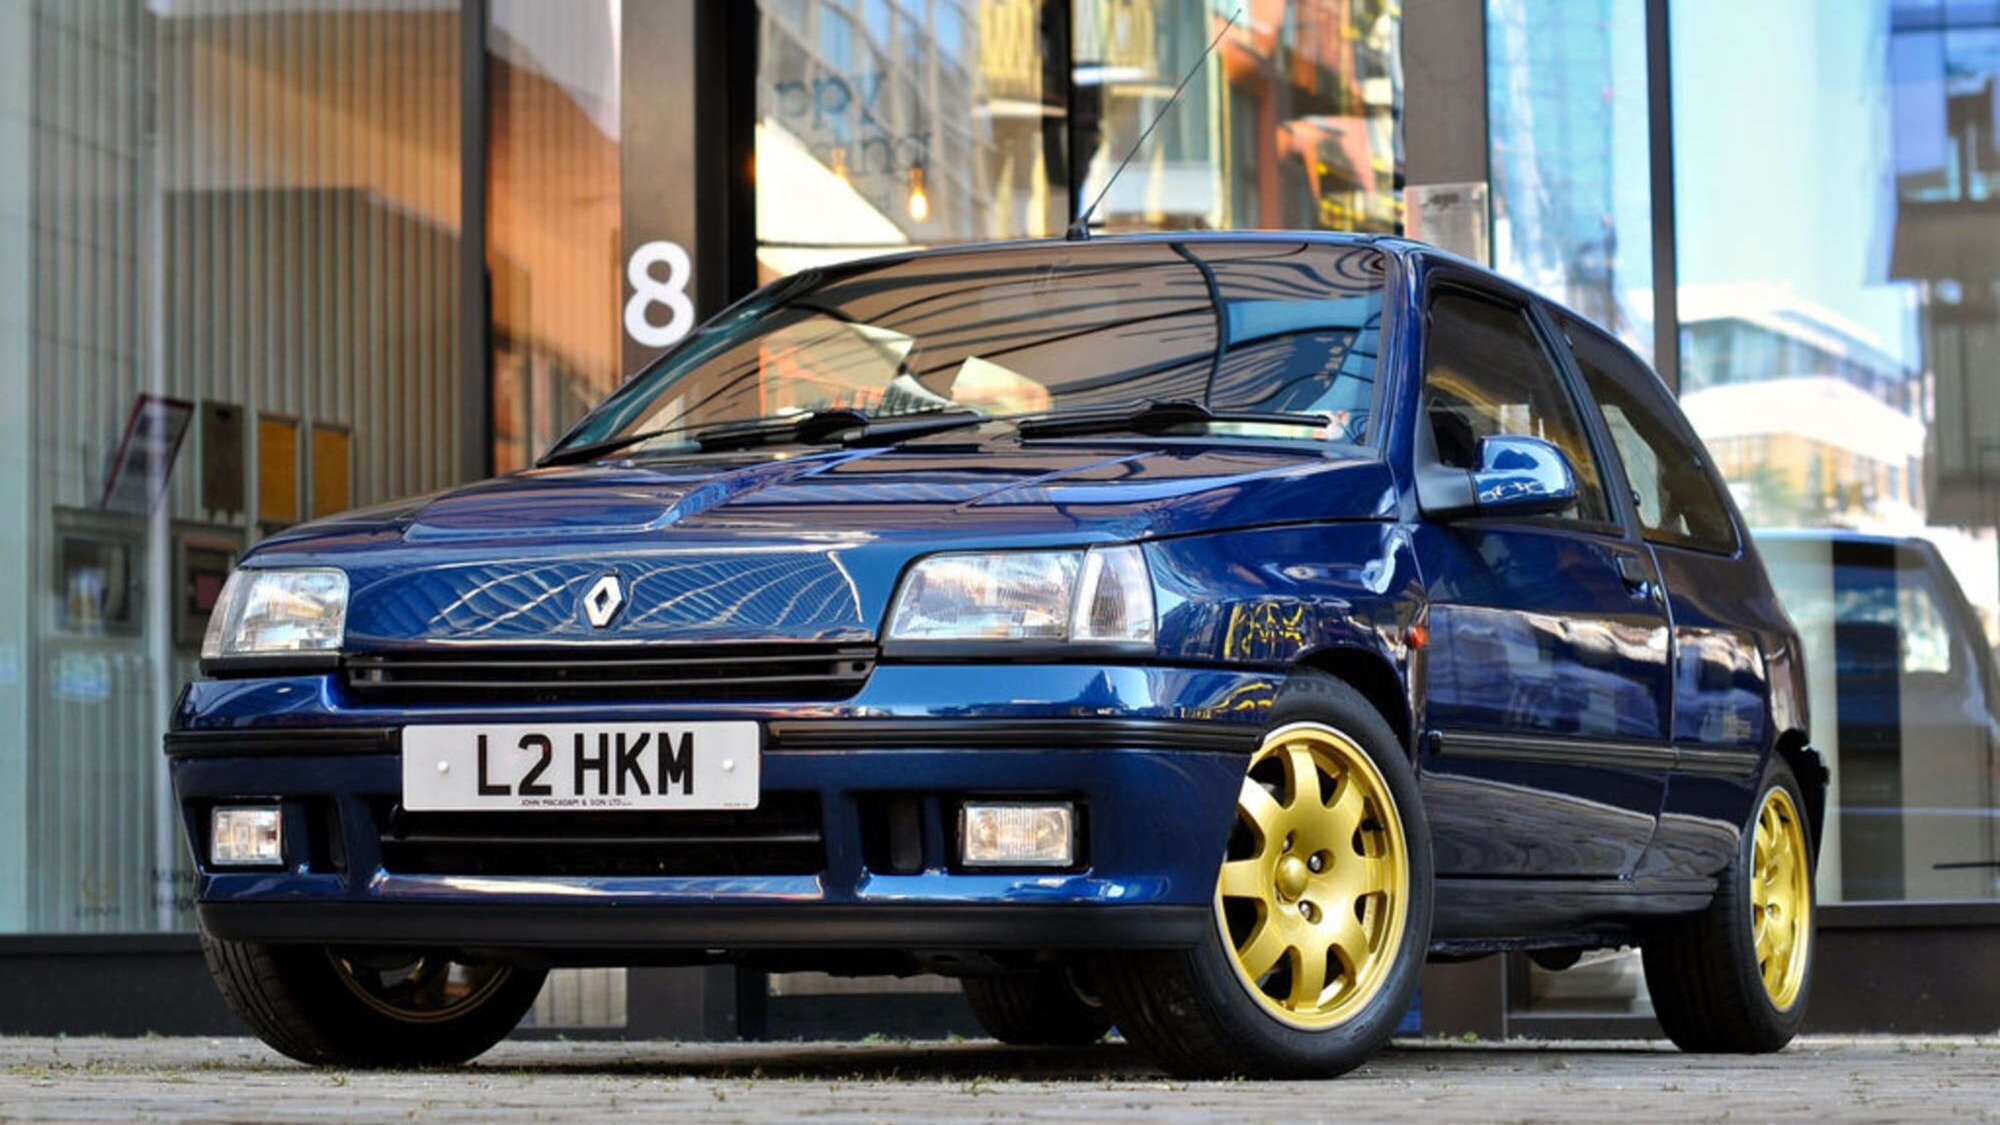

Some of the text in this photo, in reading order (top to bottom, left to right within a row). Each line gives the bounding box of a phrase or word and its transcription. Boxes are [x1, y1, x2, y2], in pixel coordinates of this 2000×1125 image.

[624, 240, 695, 347] 8
[477, 731, 694, 796] L2 HKM
